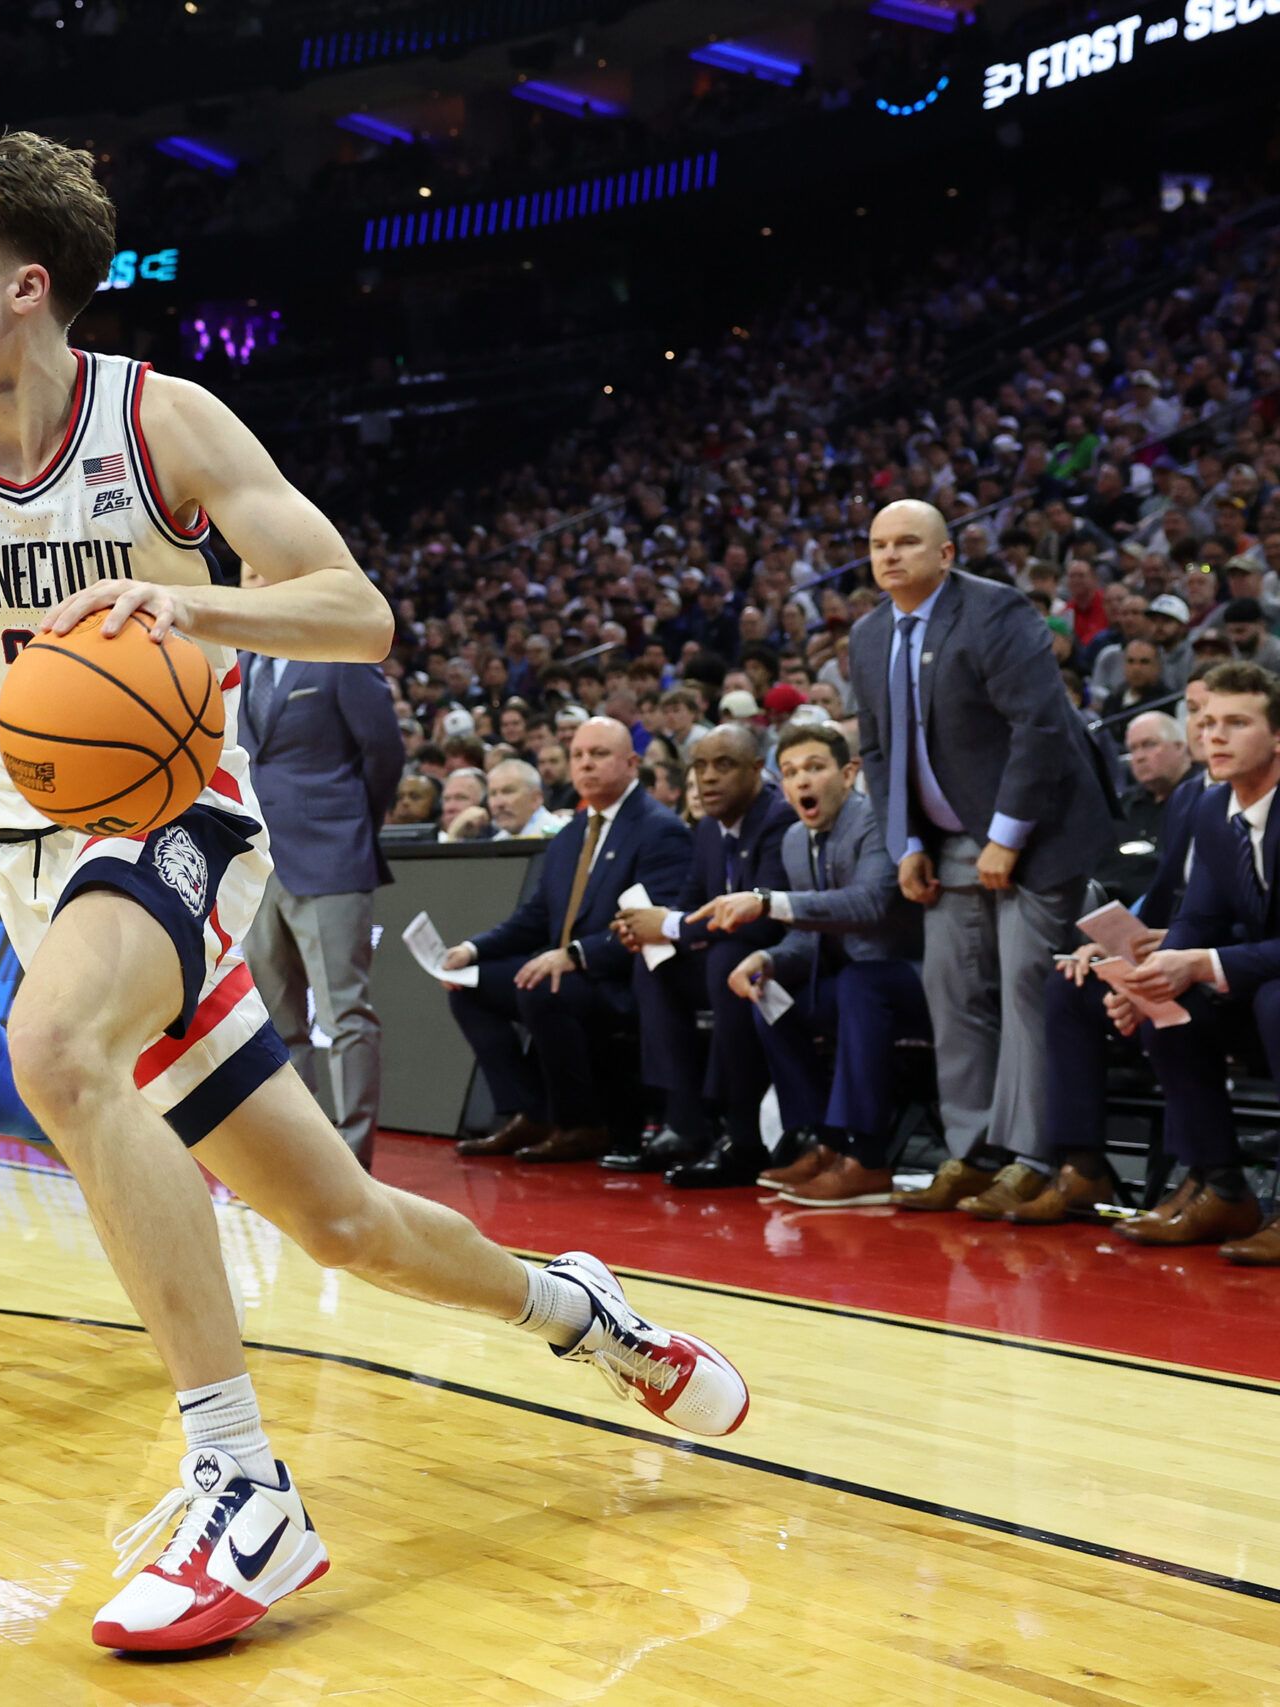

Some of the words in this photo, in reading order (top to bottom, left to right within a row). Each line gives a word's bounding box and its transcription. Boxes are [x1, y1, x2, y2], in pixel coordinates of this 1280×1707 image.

[1026, 14, 1142, 95] FIRST
[95, 488, 125, 503] BIG
[93, 496, 134, 513] EAST
